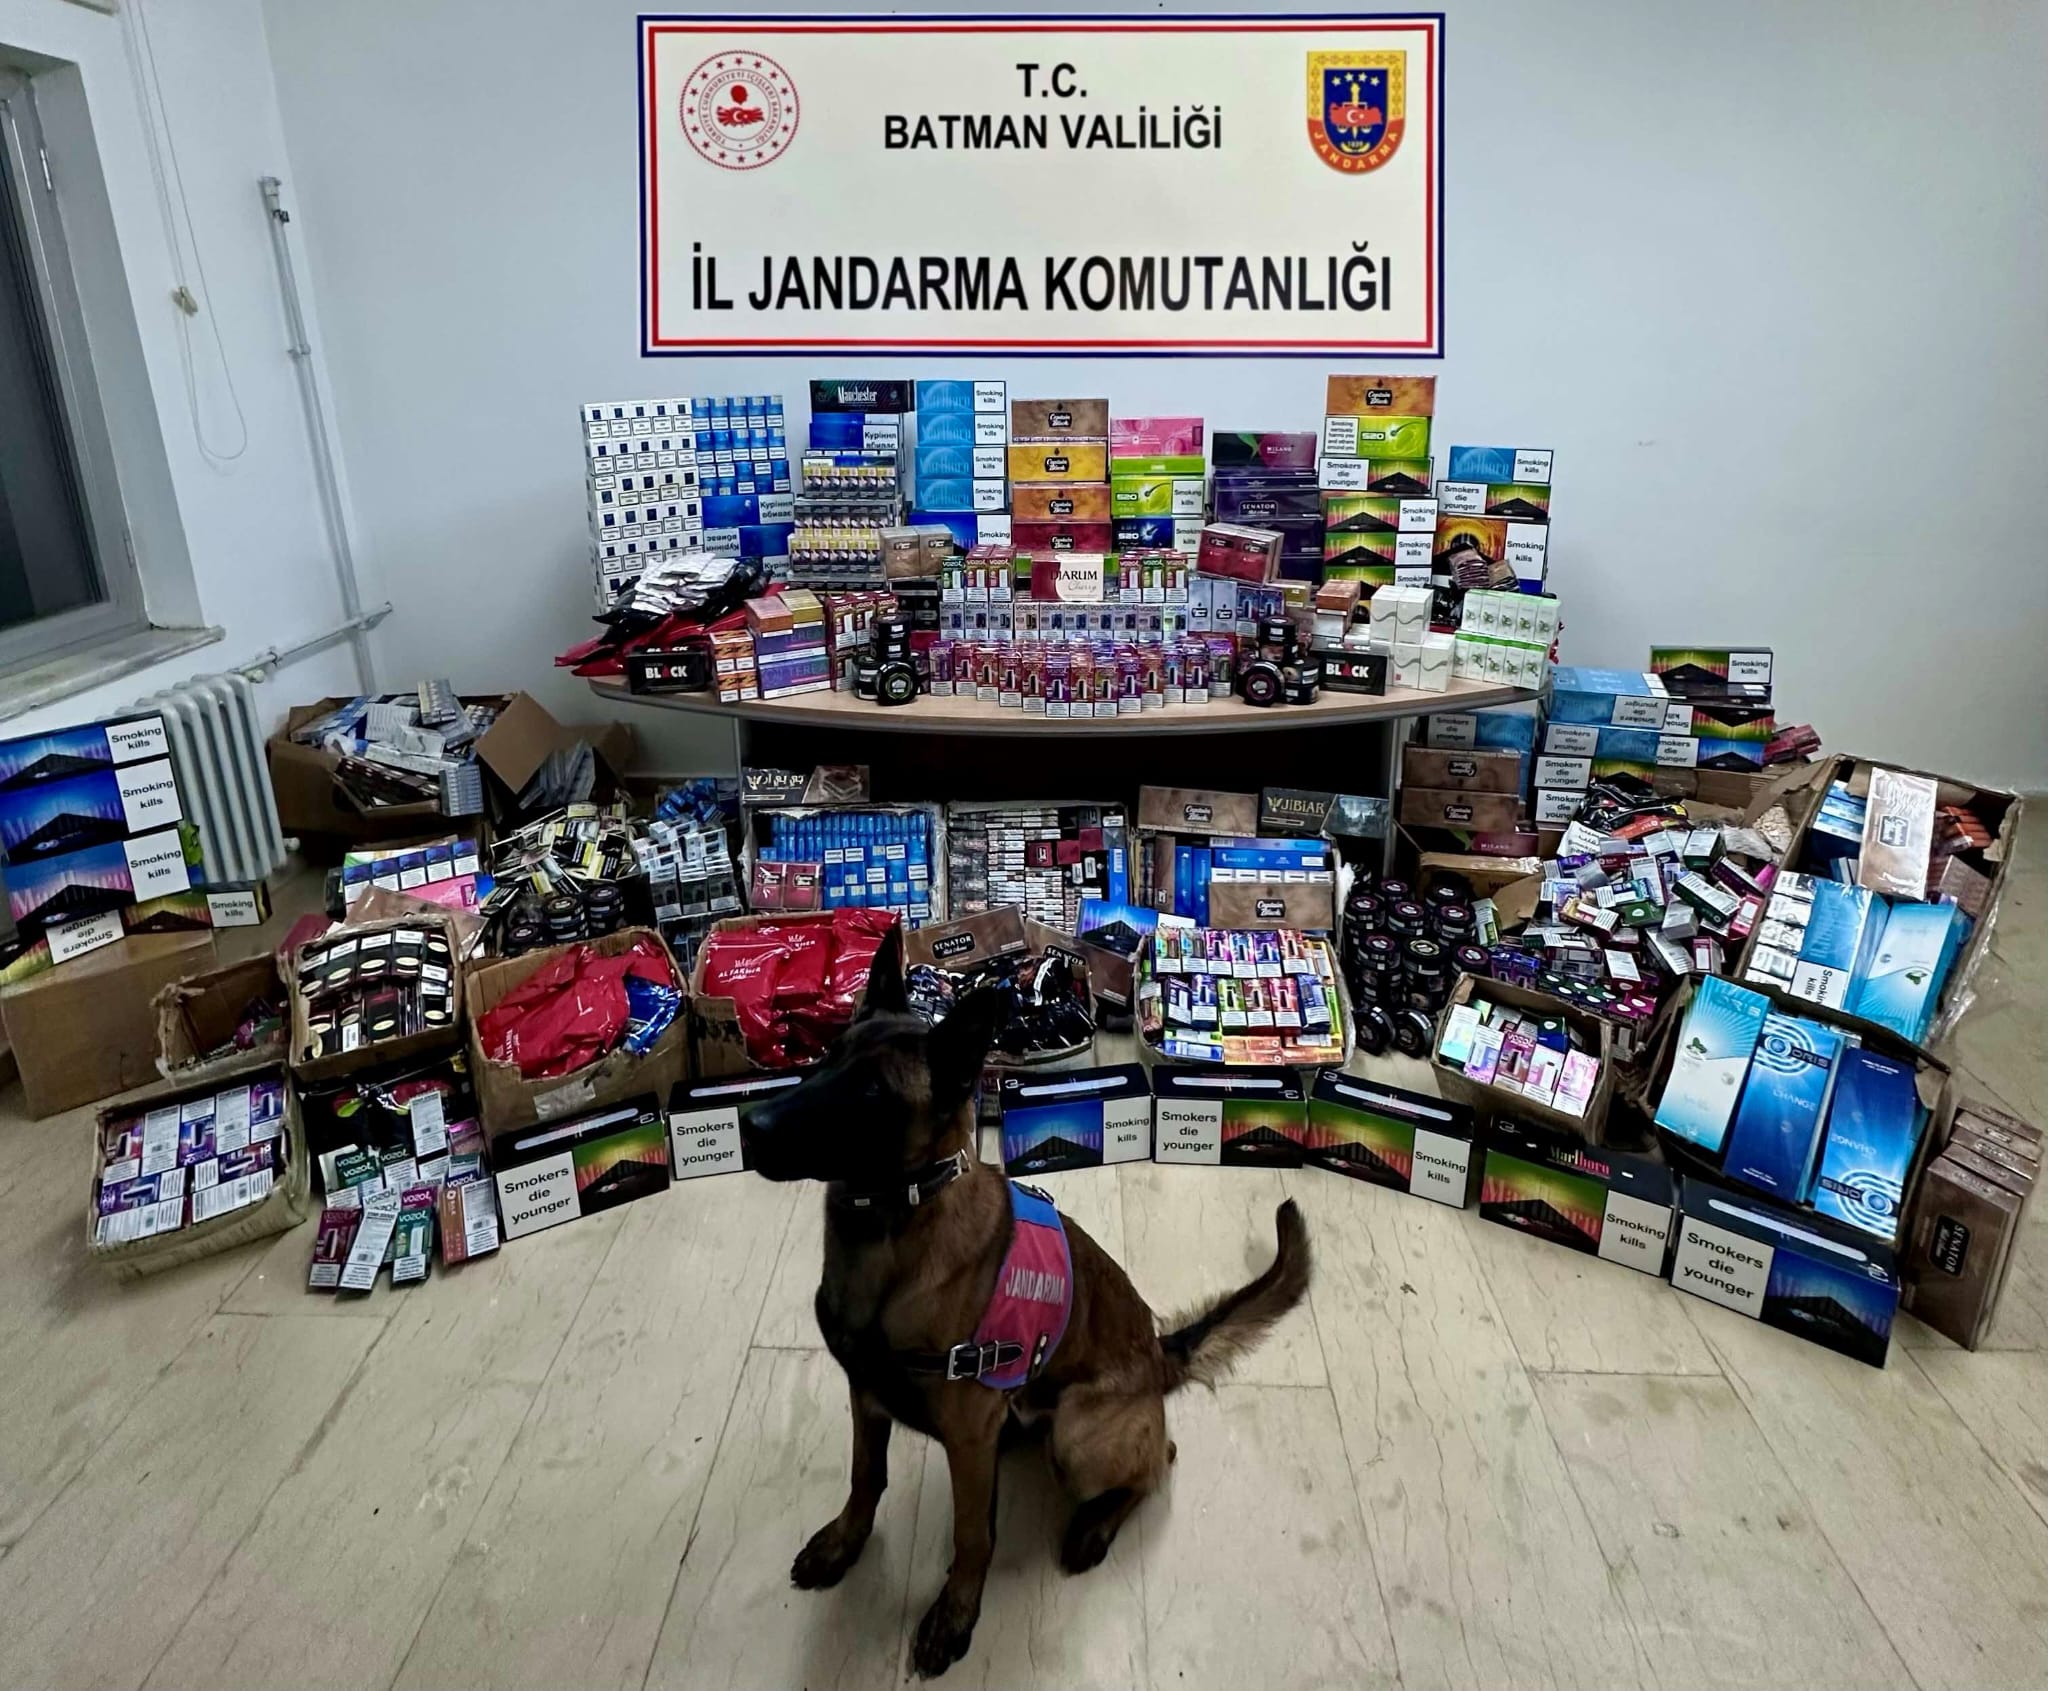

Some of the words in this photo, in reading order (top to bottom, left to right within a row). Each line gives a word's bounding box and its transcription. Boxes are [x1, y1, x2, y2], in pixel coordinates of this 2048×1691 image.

[1016, 63, 1087, 97] T.C.
[884, 115, 1048, 149] BATMAN
[1060, 105, 1222, 149] VALİLİĞİ
[1313, 131, 1398, 169] JANDARMA
[693, 242, 734, 310] İL
[749, 256, 1028, 311] JANDARMA
[1045, 240, 1391, 311] KOMUTANLIĞI
[1517, 459, 1549, 467] Smoking
[1444, 485, 1480, 494] Smokers
[1398, 541, 1431, 549] Smoking
[1507, 540, 1544, 551] Smoking
[1515, 554, 1533, 562] kills
[1397, 575, 1430, 583] Smoking
[1731, 660, 1769, 669] Smoking
[1740, 667, 1758, 675] kills
[1436, 716, 1469, 725] Smokers
[1666, 720, 1690, 729] Smok
[111, 727, 162, 743] Smoking
[1436, 733, 1466, 741] younger
[1555, 728, 1591, 737] Smokers
[127, 740, 151, 750] kills
[1554, 743, 1587, 752] younger
[1664, 747, 1678, 755] die
[1545, 760, 1583, 769] Smokers
[1555, 768, 1569, 776] die
[1544, 776, 1580, 785] younger
[122, 779, 174, 798] Smoking
[139, 797, 164, 809] kills
[1185, 804, 1212, 814] Captain
[1187, 812, 1208, 822] Black
[130, 849, 182, 868] Smoking
[147, 867, 171, 880] kills
[211, 899, 254, 909] Smoking
[1257, 900, 1284, 910] Captain
[225, 909, 244, 918] kills
[1260, 908, 1283, 917] Black
[77, 928, 95, 939] die
[62, 930, 113, 954] Smokers
[934, 935, 972, 950] SENATOR
[1804, 977, 1815, 996] kills
[1791, 1050, 1829, 1068] ORIS
[1773, 1089, 1816, 1111] CHANGE
[1105, 1116, 1150, 1130] Smoking
[1161, 1111, 1217, 1123] Smokers
[676, 1120, 735, 1136] Smokers
[1179, 1126, 1199, 1137] die
[696, 1137, 717, 1148] die
[1117, 1133, 1137, 1143] kills
[1163, 1139, 1214, 1153] younger
[681, 1150, 735, 1166] younger
[1415, 1151, 1467, 1174] Smoking
[1551, 1145, 1611, 1176] Marlboro
[504, 1166, 570, 1194] Smokers
[1427, 1171, 1451, 1184] kills
[528, 1187, 551, 1202] die
[1821, 1178, 1861, 1200] ORIS
[511, 1196, 571, 1225] younger
[1606, 1213, 1666, 1240] Smoking
[1619, 1234, 1646, 1249] kills
[1686, 1231, 1764, 1269] Smokers
[1944, 1224, 1965, 1273] SENATOR
[1707, 1257, 1735, 1275] die
[1683, 1264, 1755, 1299] younger
